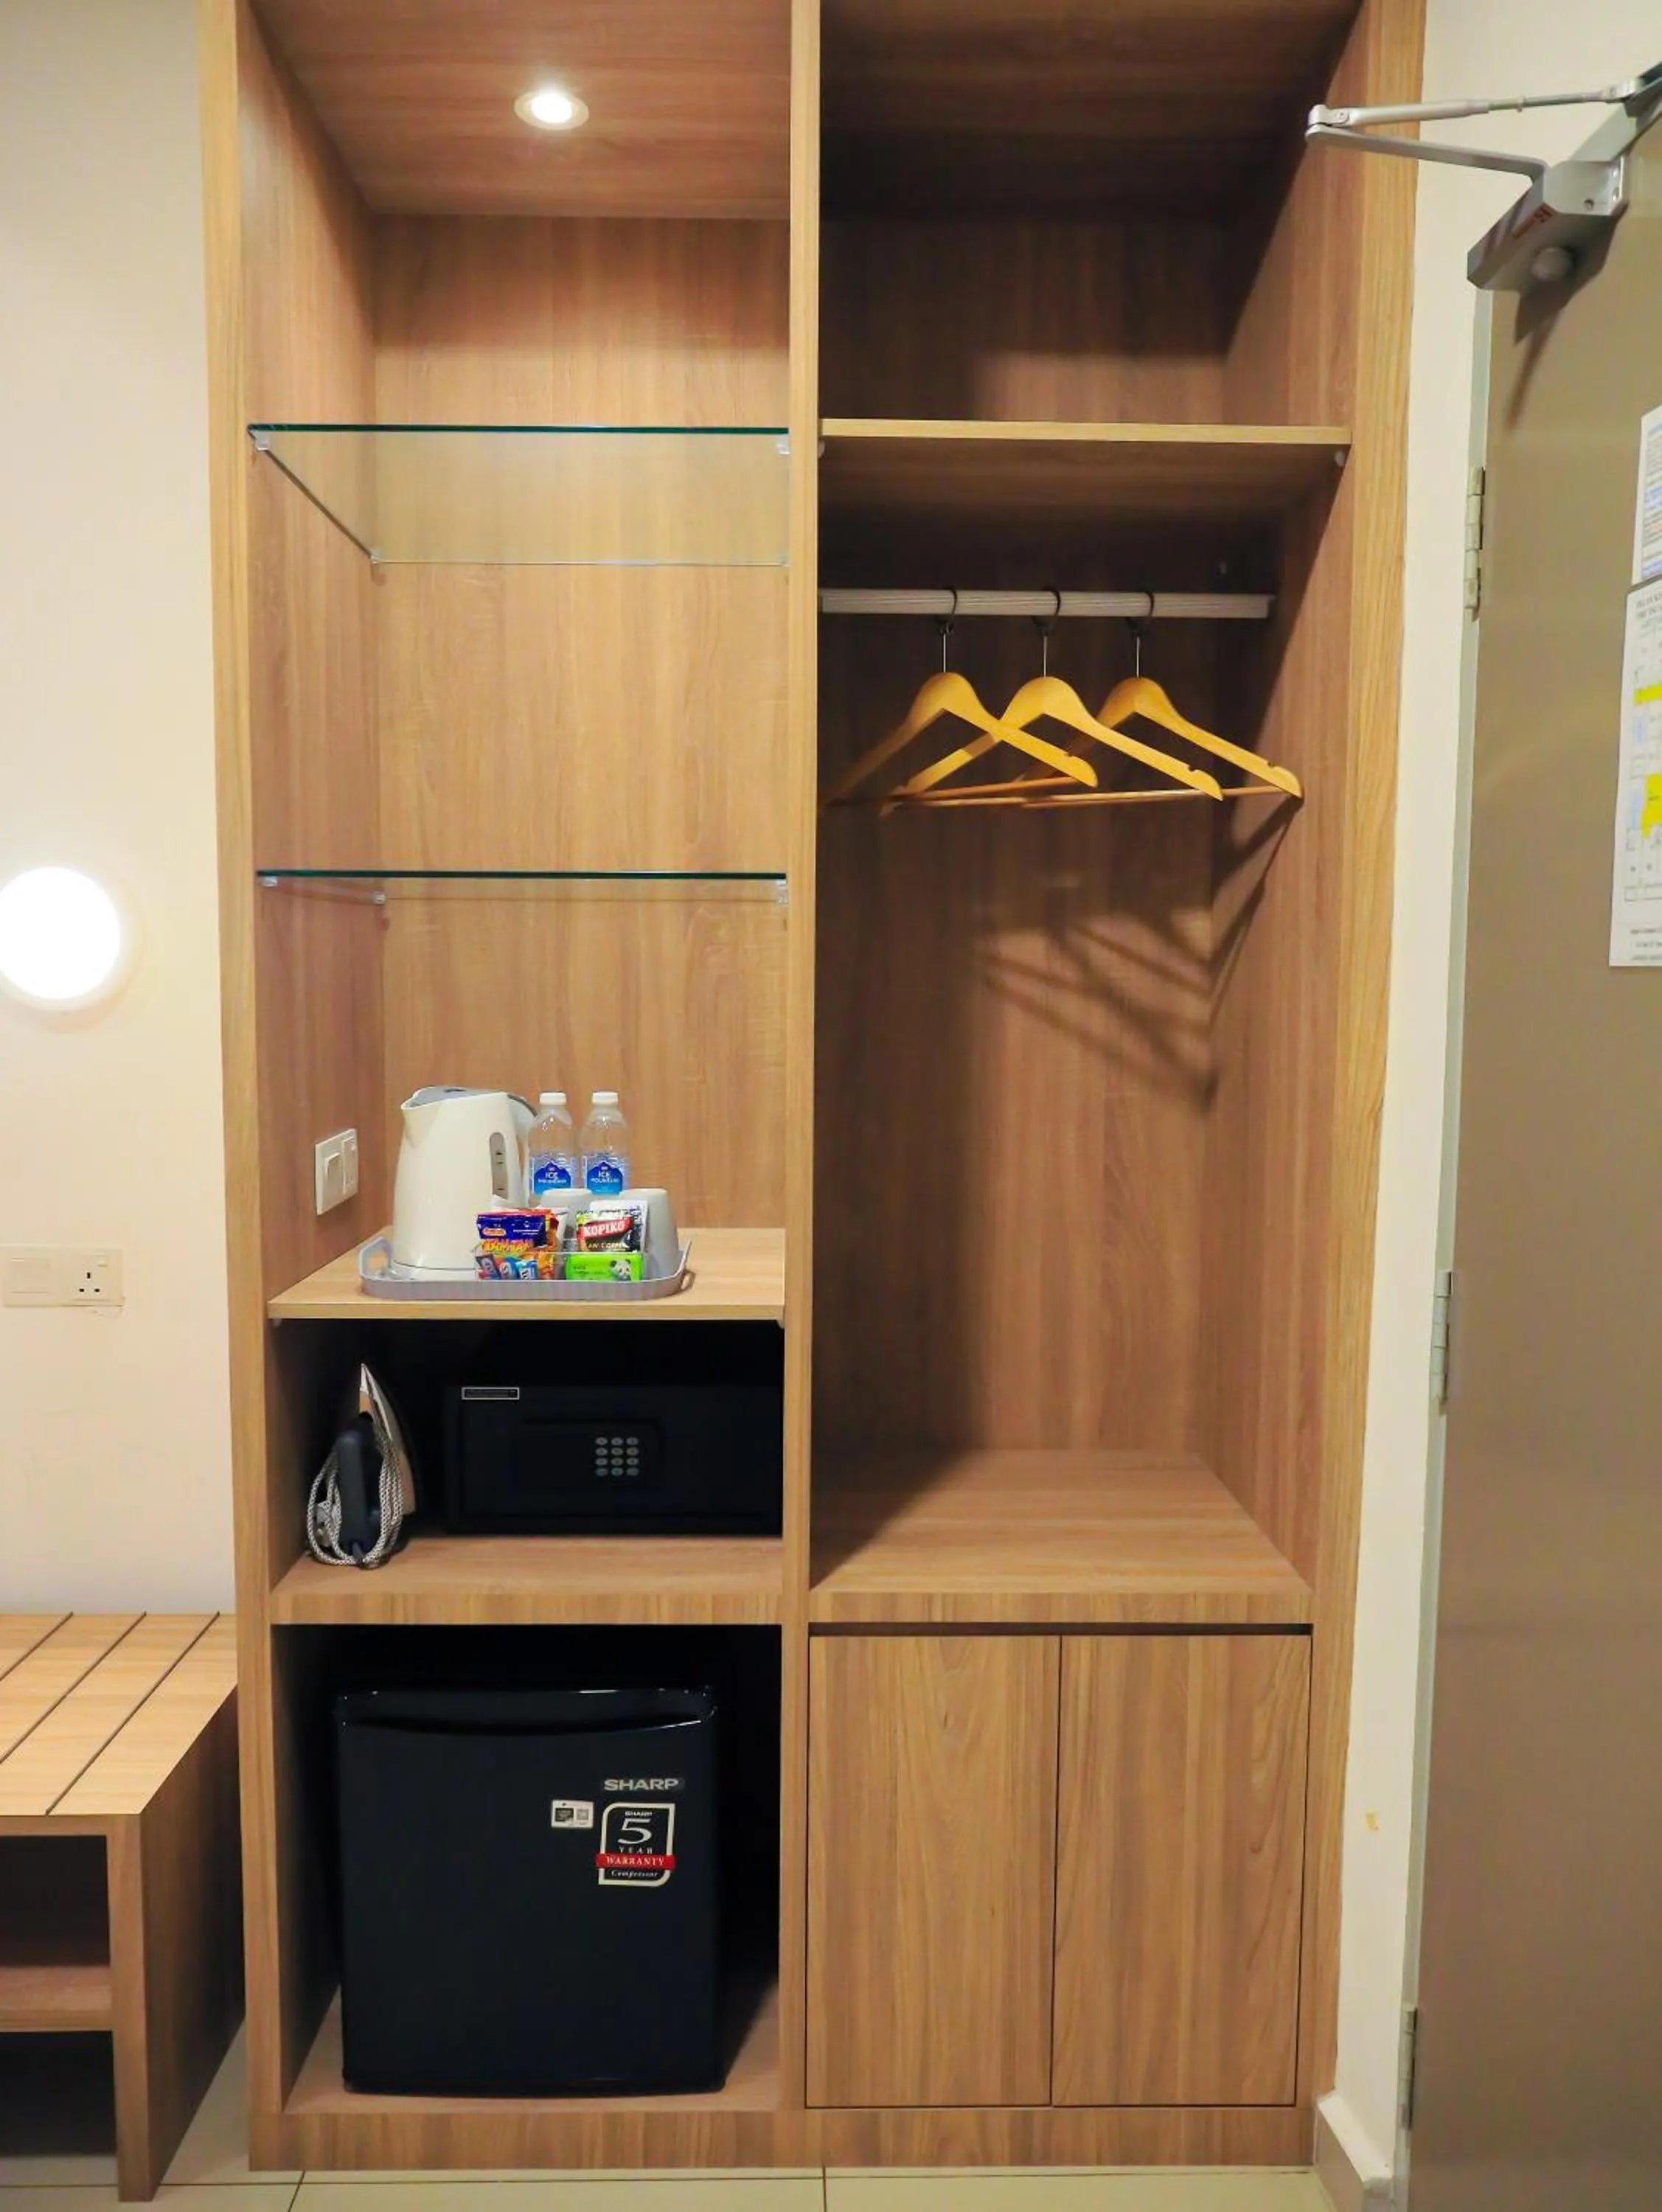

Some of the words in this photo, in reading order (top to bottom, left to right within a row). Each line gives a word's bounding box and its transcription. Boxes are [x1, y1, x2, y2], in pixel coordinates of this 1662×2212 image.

[583, 1220, 626, 1237] KOPIKO
[604, 1778, 679, 1791] SHARP
[617, 1818, 653, 1845] 5
[619, 1846, 653, 1854] YEAR
[606, 1856, 665, 1866] WARRANTY
